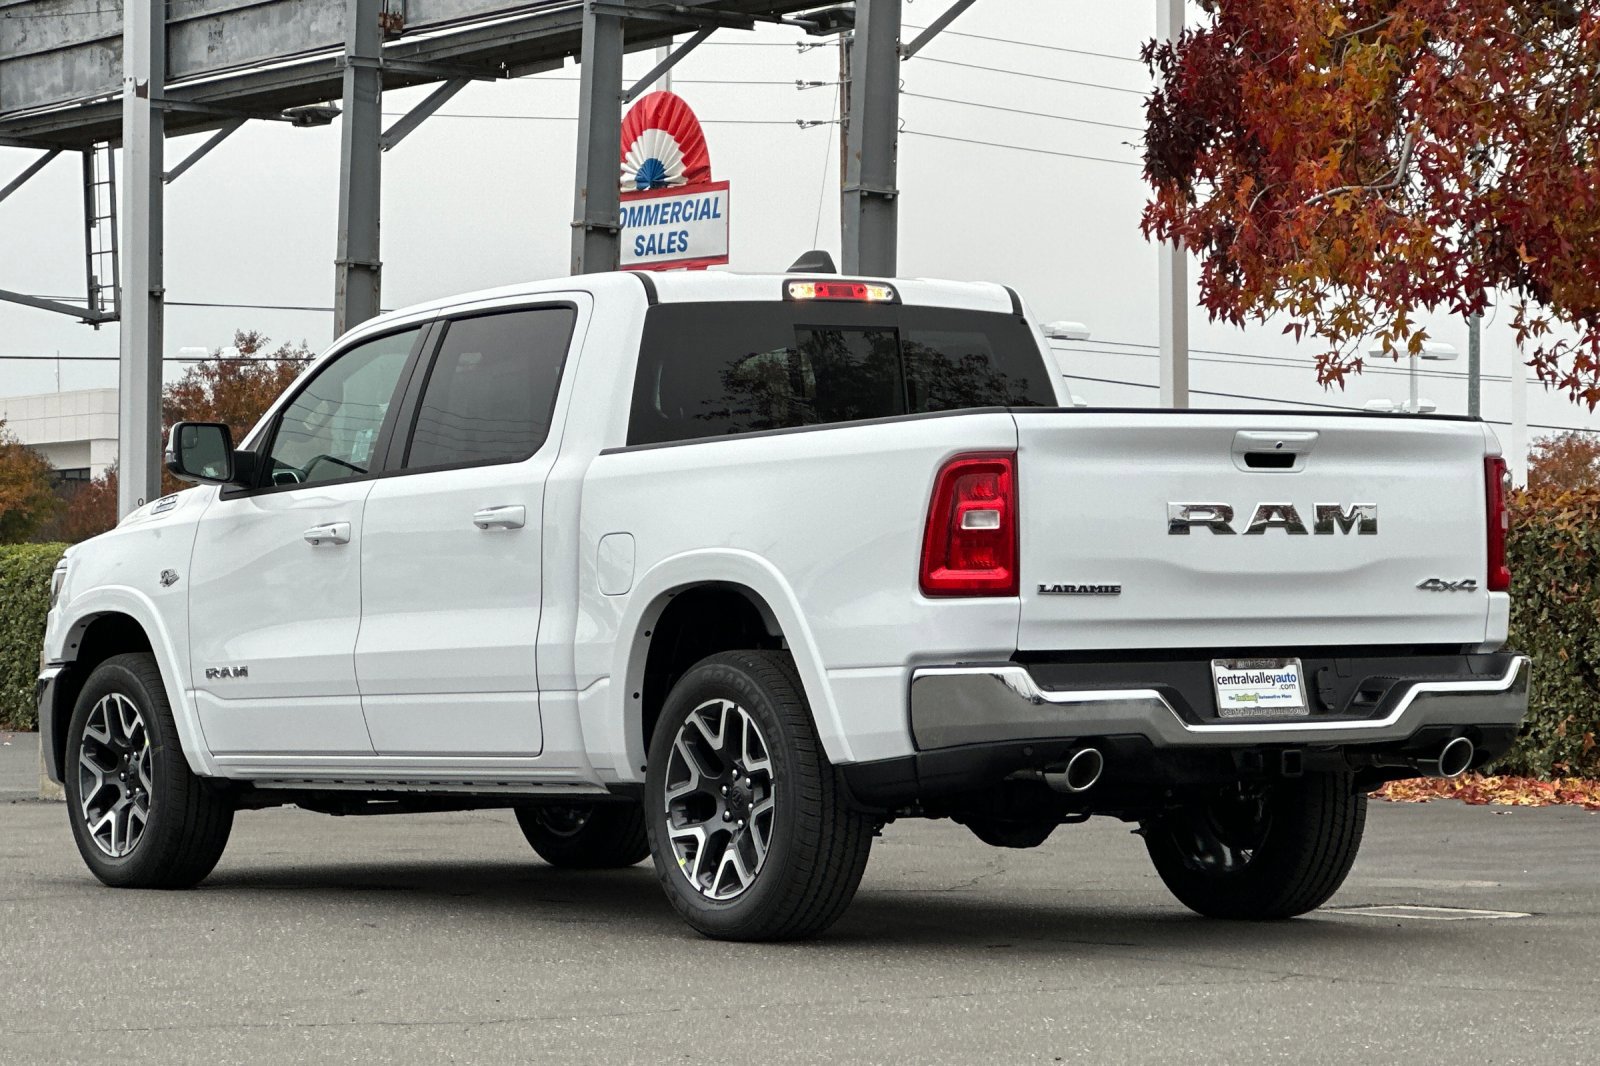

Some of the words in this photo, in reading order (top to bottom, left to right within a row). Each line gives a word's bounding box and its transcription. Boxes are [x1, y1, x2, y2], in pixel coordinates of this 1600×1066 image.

[620, 197, 721, 230] OMMERCIAL
[634, 230, 689, 257] SALES
[1167, 501, 1378, 535] RAM
[1037, 584, 1121, 595] LARAMIE
[1415, 578, 1479, 592] 4x4
[205, 665, 249, 680] RAM
[1217, 672, 1297, 686] centralvalleyauto
